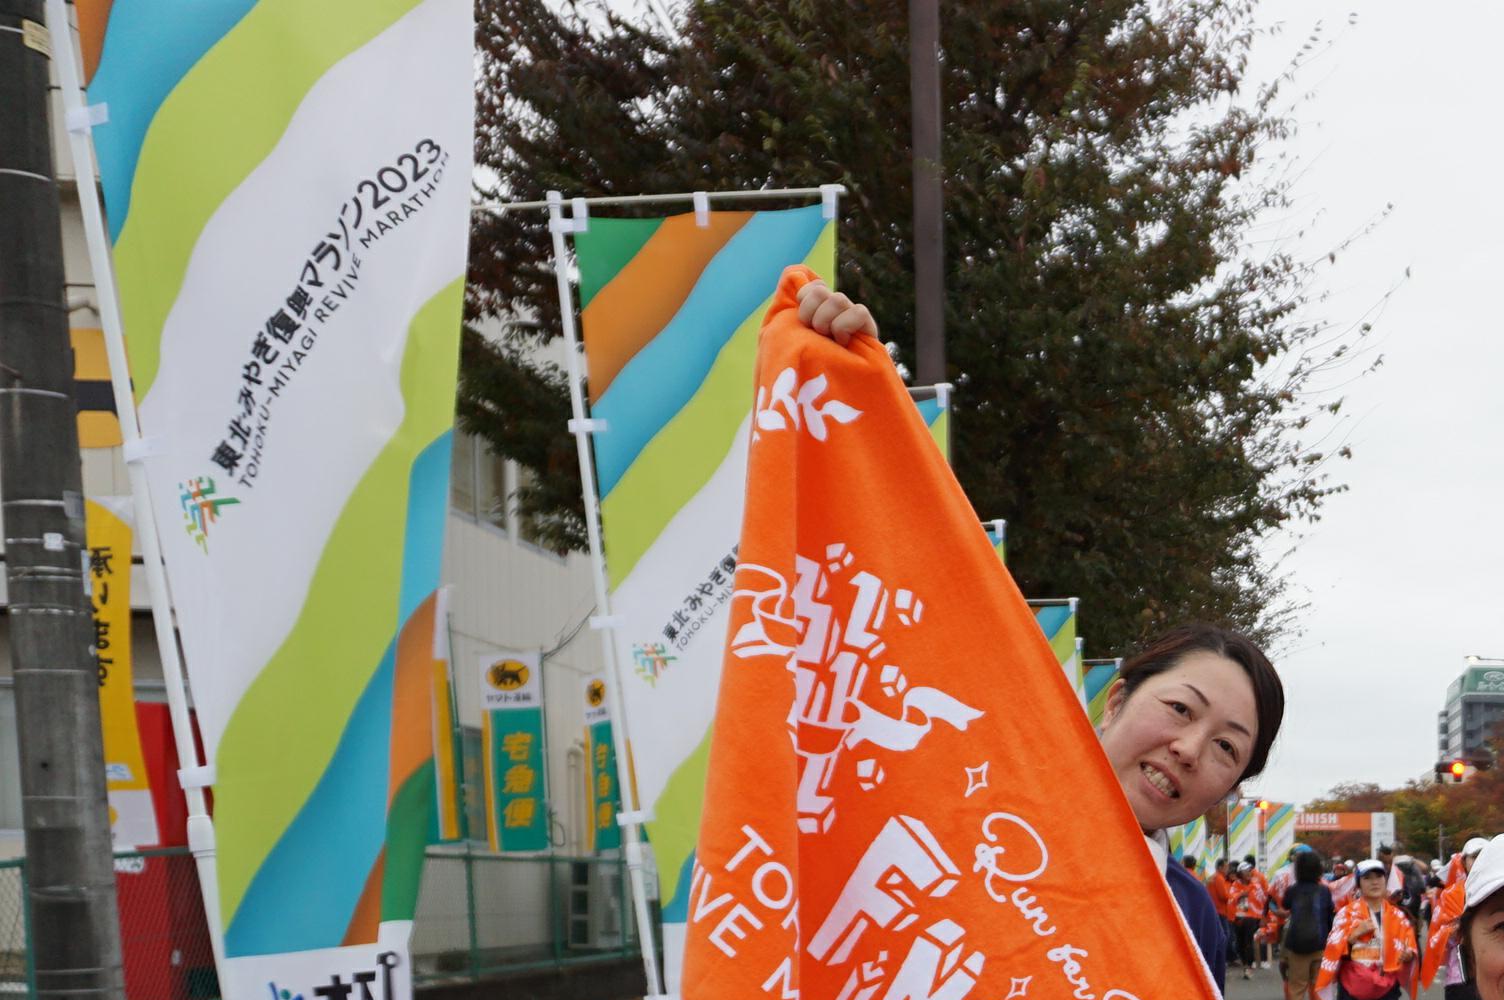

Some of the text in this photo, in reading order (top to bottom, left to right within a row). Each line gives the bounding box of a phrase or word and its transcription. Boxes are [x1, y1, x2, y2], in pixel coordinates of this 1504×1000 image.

[237, 151, 450, 490] TOHOKU-MIYAGI REVIVE MARATHON
[972, 811, 1057, 938] Run
[1046, 943, 1096, 1000] for
